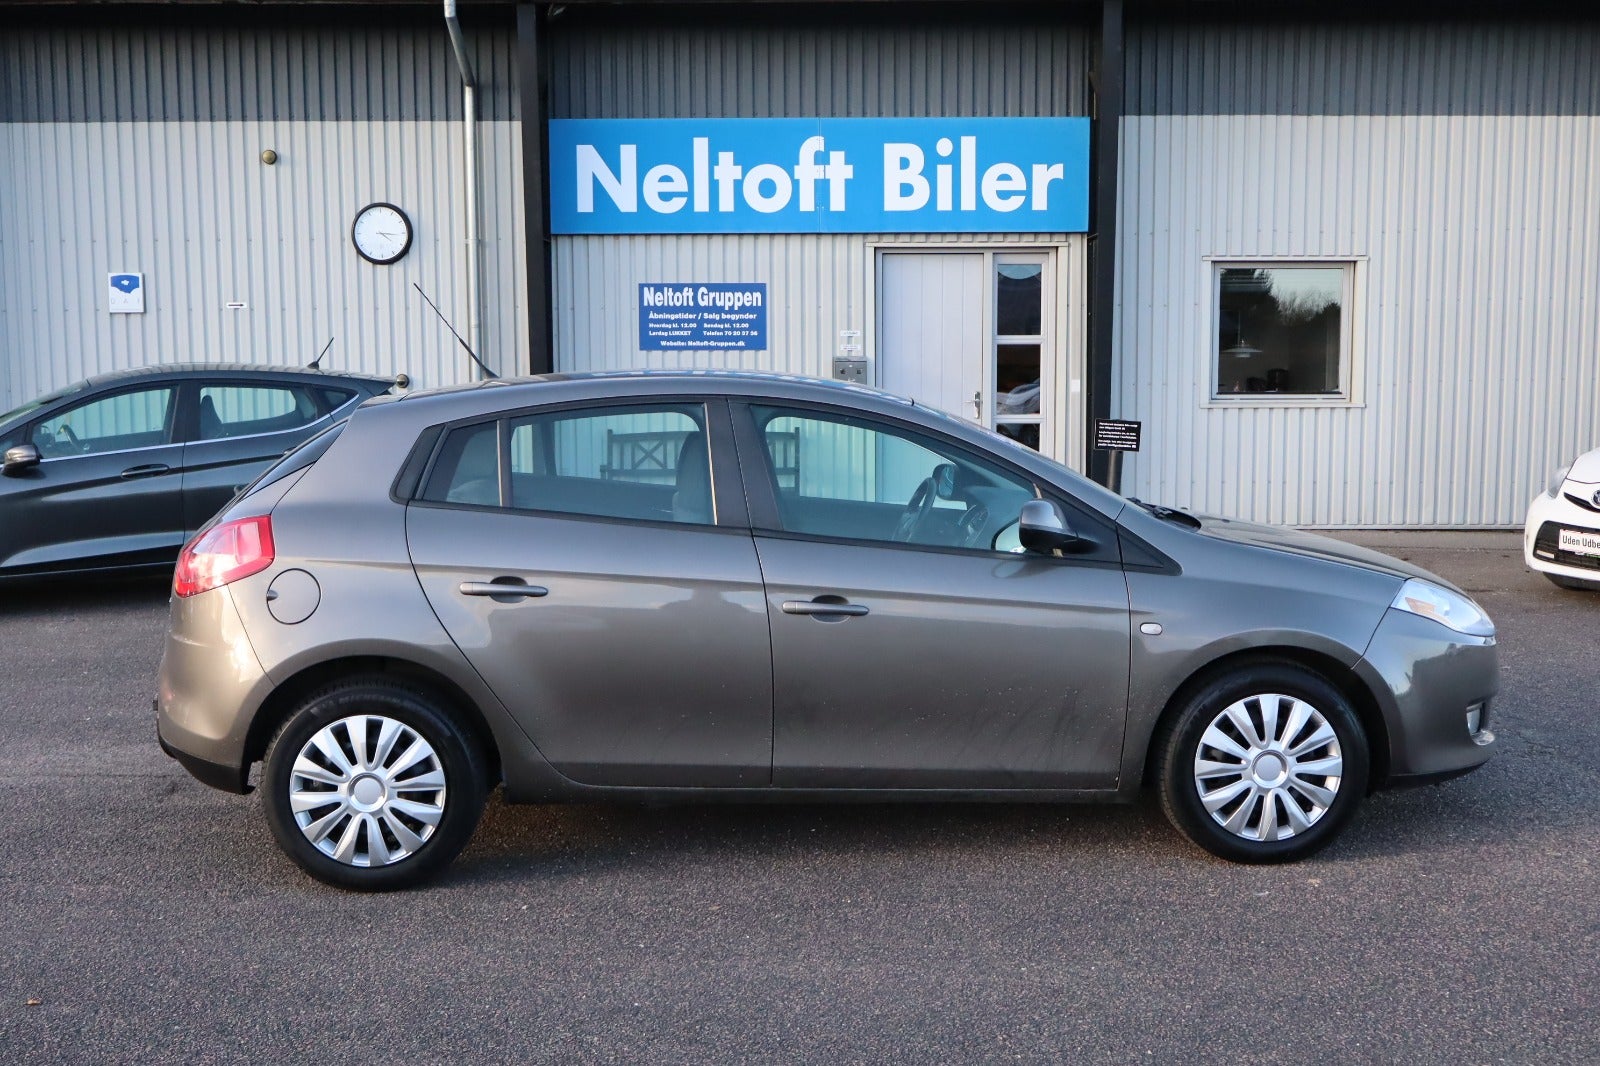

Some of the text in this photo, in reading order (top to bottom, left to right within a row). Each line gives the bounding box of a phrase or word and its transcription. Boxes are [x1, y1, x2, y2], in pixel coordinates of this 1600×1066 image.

[576, 135, 1064, 214] Neltoft Biler
[643, 286, 762, 311] Neltoft Gruppen
[648, 311, 697, 320] Åbningstider
[703, 312, 720, 320] Salg
[721, 312, 757, 320] begynder
[1562, 535, 1580, 546] Uden
